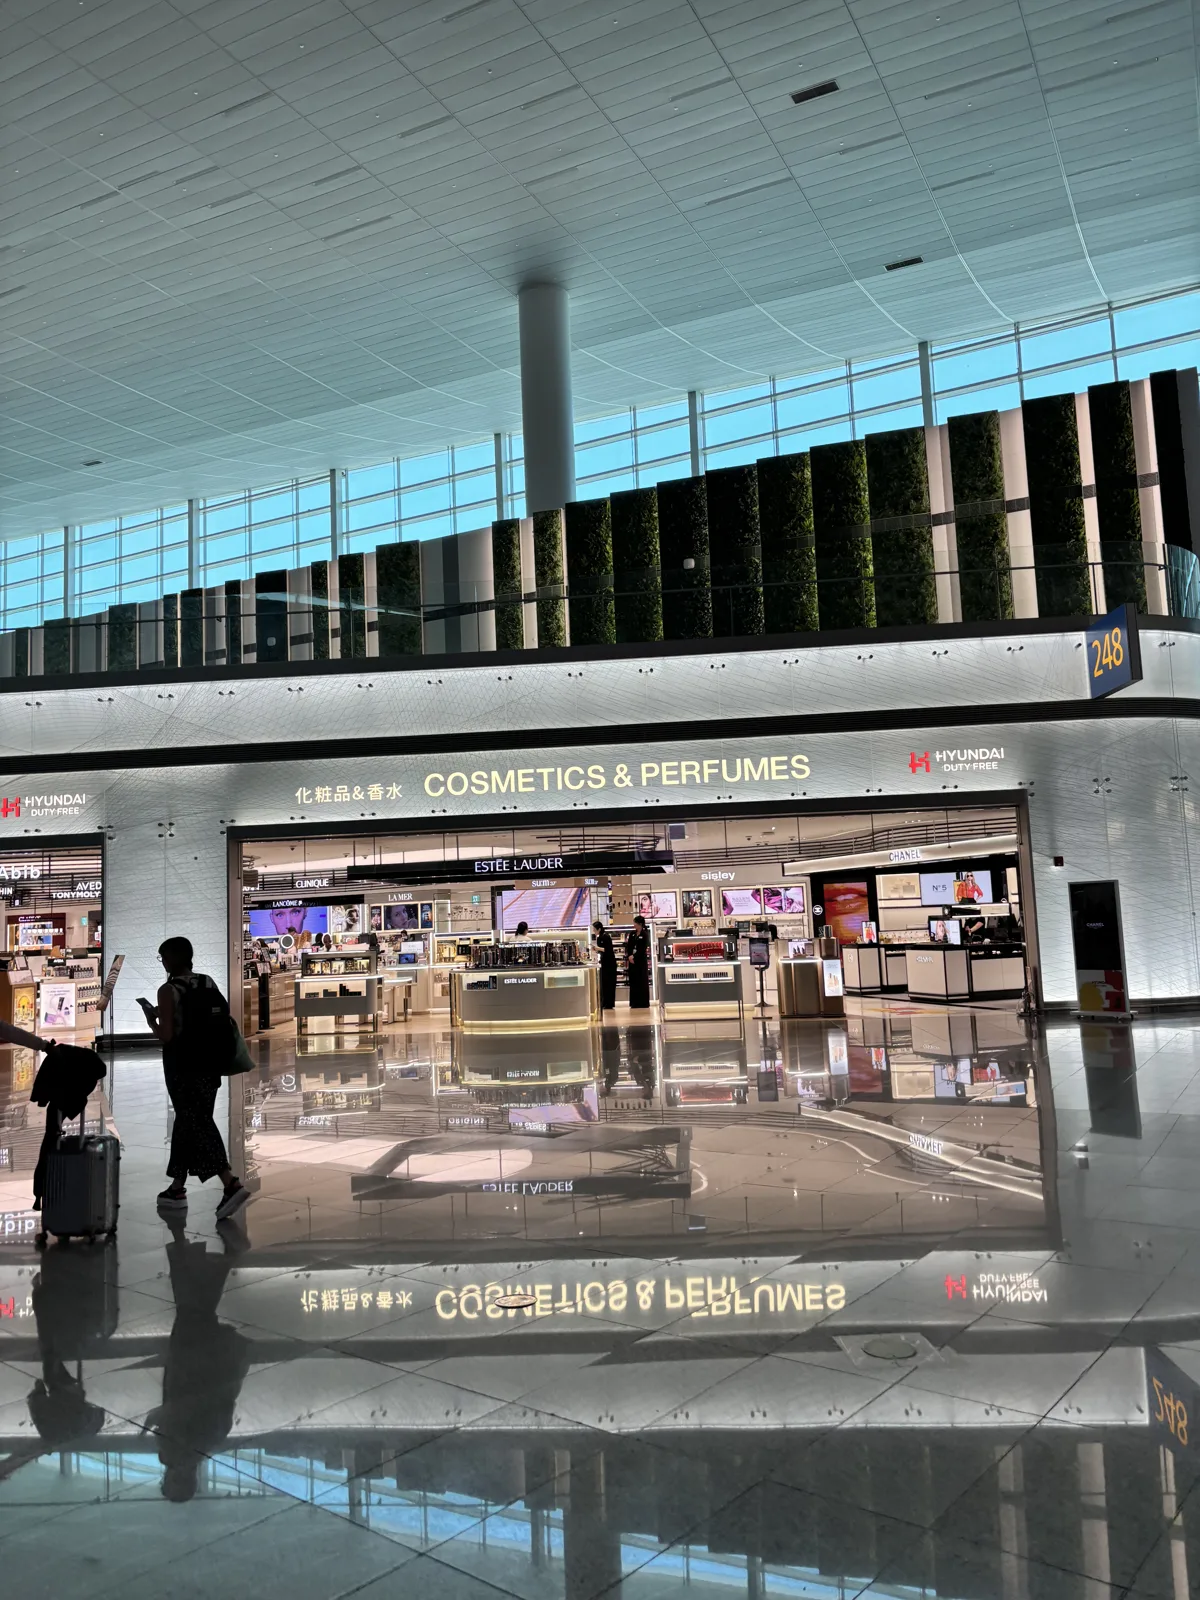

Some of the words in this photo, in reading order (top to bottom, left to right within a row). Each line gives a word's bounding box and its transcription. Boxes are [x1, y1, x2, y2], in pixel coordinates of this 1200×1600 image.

[1092, 627, 1123, 678] 248
[935, 747, 1005, 762] HYUNDAI
[424, 764, 606, 797] COSMETICS
[613, 763, 634, 788] &
[641, 754, 811, 787] PERFUMES
[25, 793, 86, 808] HYUNDAI
[888, 849, 921, 862] CHANEL
[513, 857, 564, 871] LAUDER
[701, 871, 736, 881] sisley
[295, 879, 330, 889] CLINIQUE
[52, 890, 101, 899] TONYMOLY
[388, 894, 397, 902] LA
[397, 893, 413, 901] MER
